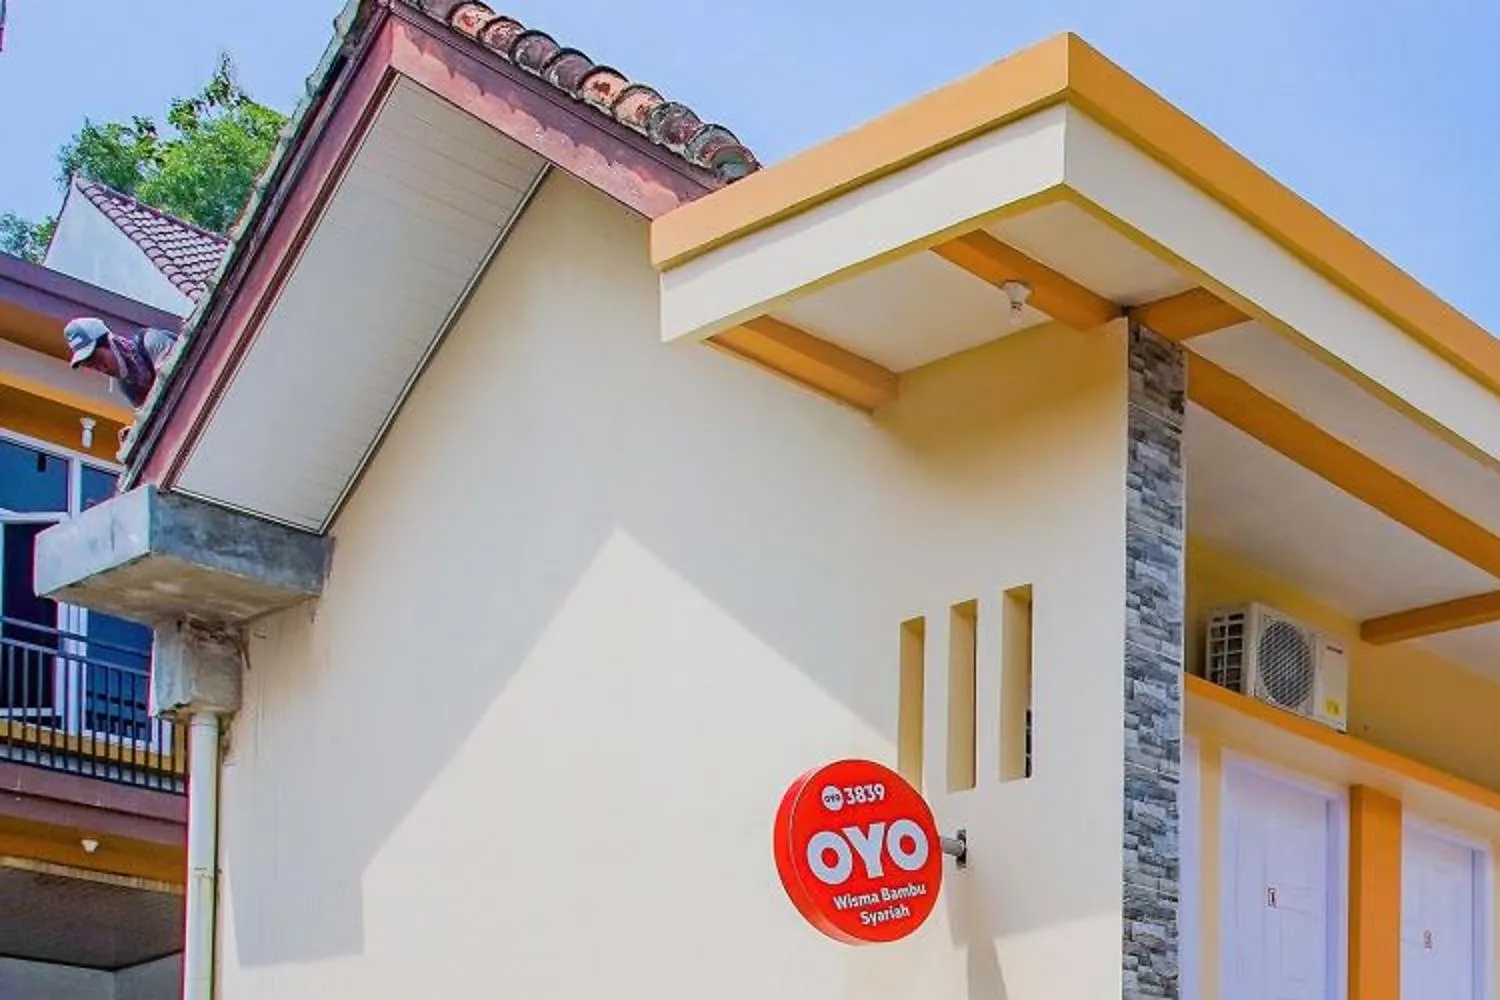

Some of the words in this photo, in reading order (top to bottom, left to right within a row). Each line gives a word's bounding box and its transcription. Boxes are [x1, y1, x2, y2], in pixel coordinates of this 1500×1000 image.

[843, 784, 885, 804] 3839
[807, 819, 928, 885] OYO
[833, 893, 880, 910] Wisma
[880, 883, 927, 901] Bambu
[860, 904, 911, 926] Syariah
